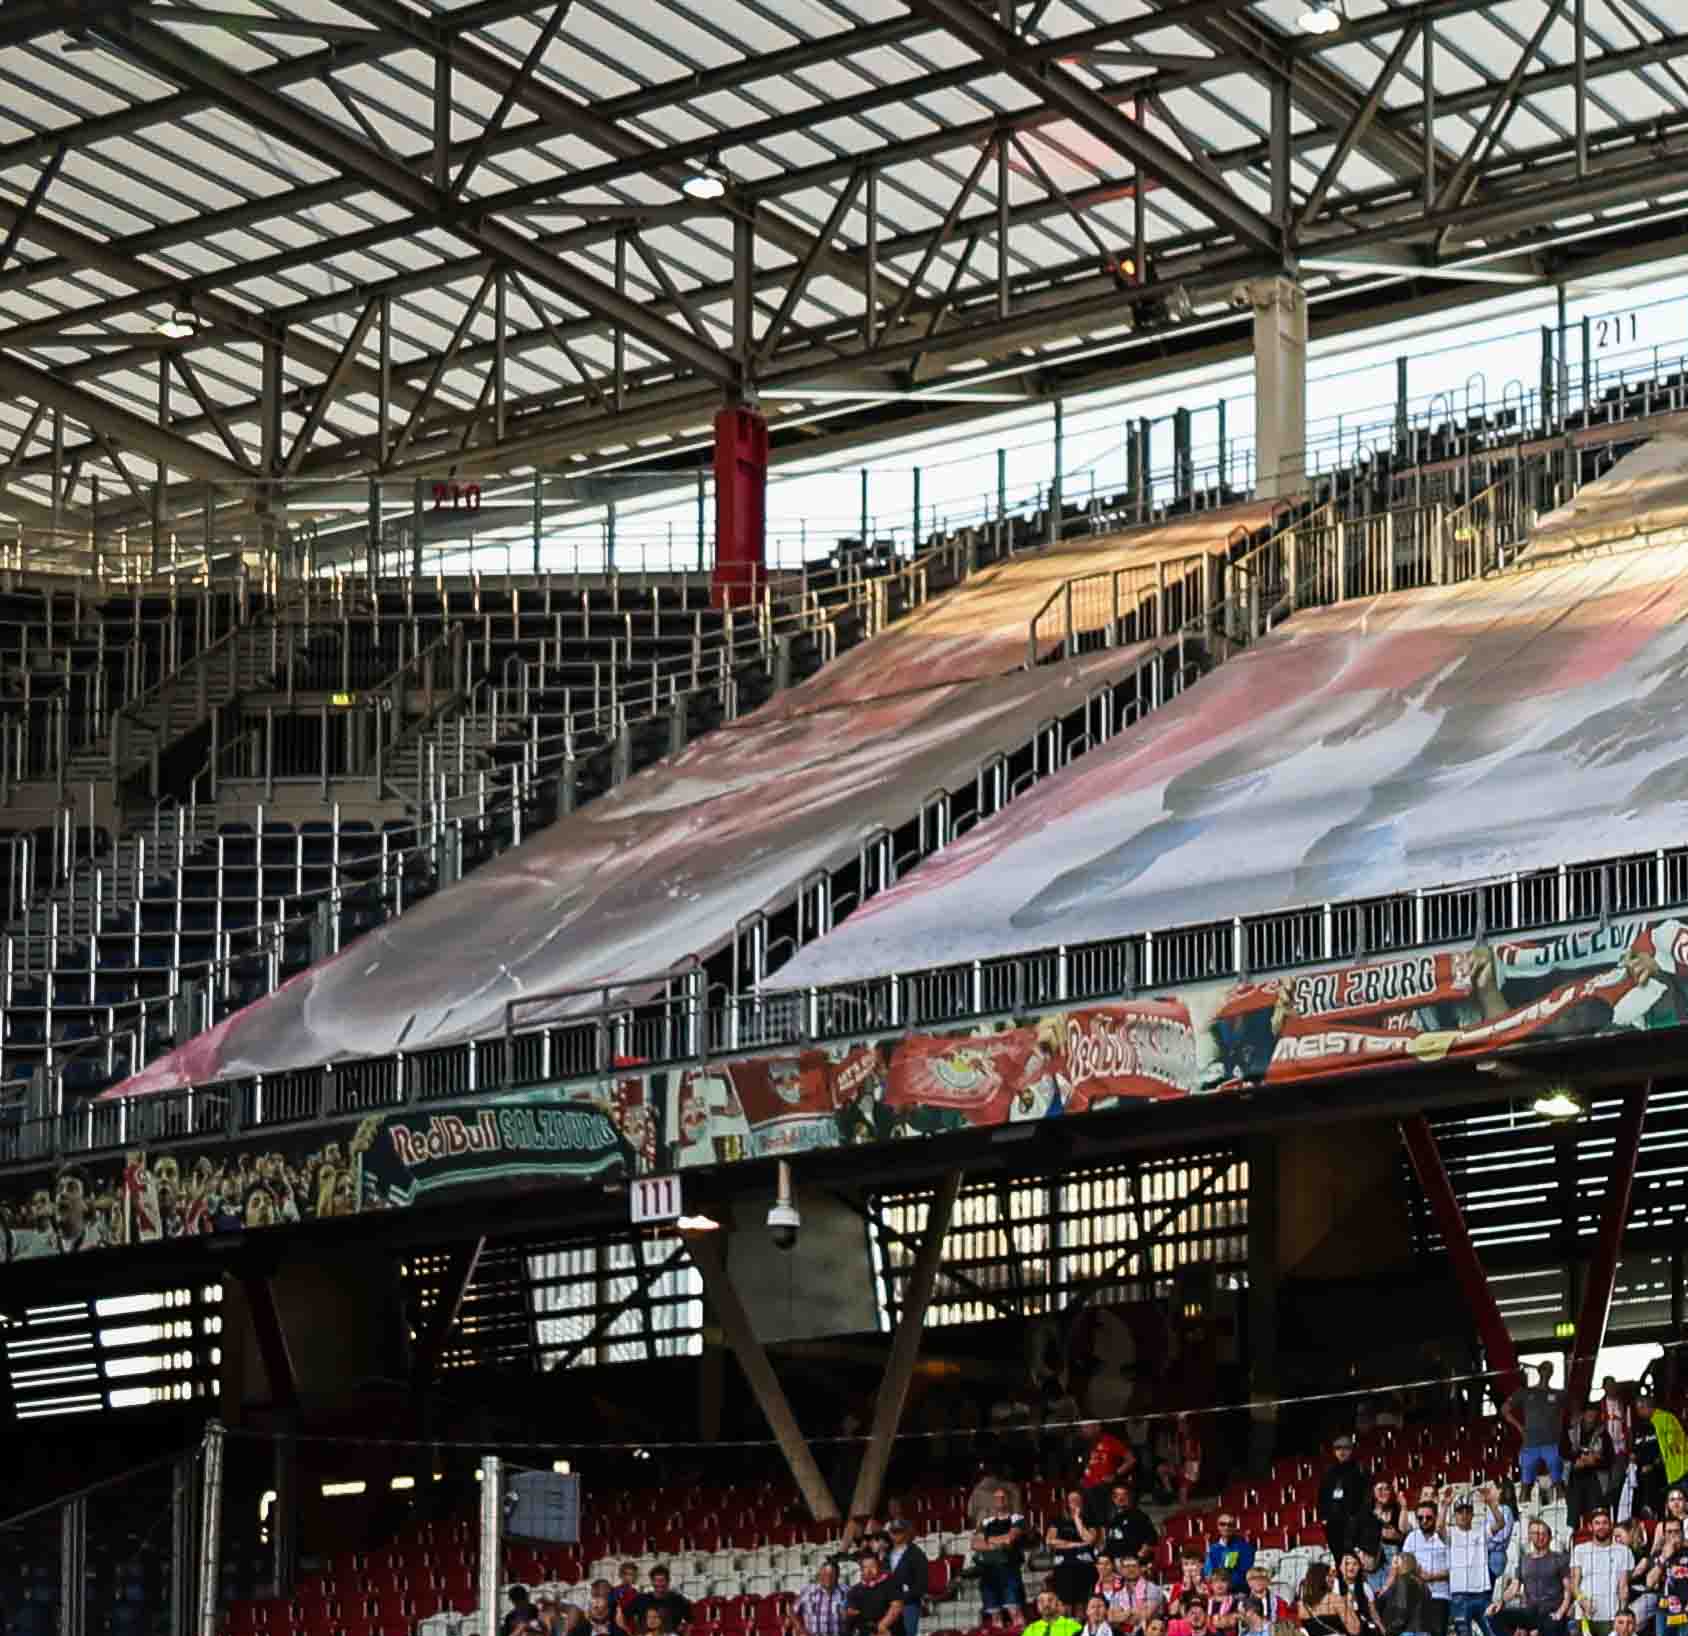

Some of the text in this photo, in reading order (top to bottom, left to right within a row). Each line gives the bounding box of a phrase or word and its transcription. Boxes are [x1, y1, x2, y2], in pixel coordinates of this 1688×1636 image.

[1596, 313, 1638, 348] 211
[1294, 954, 1438, 1018] SALZBURG
[500, 1106, 619, 1151] SALZBURG
[640, 1181, 674, 1216] 111
